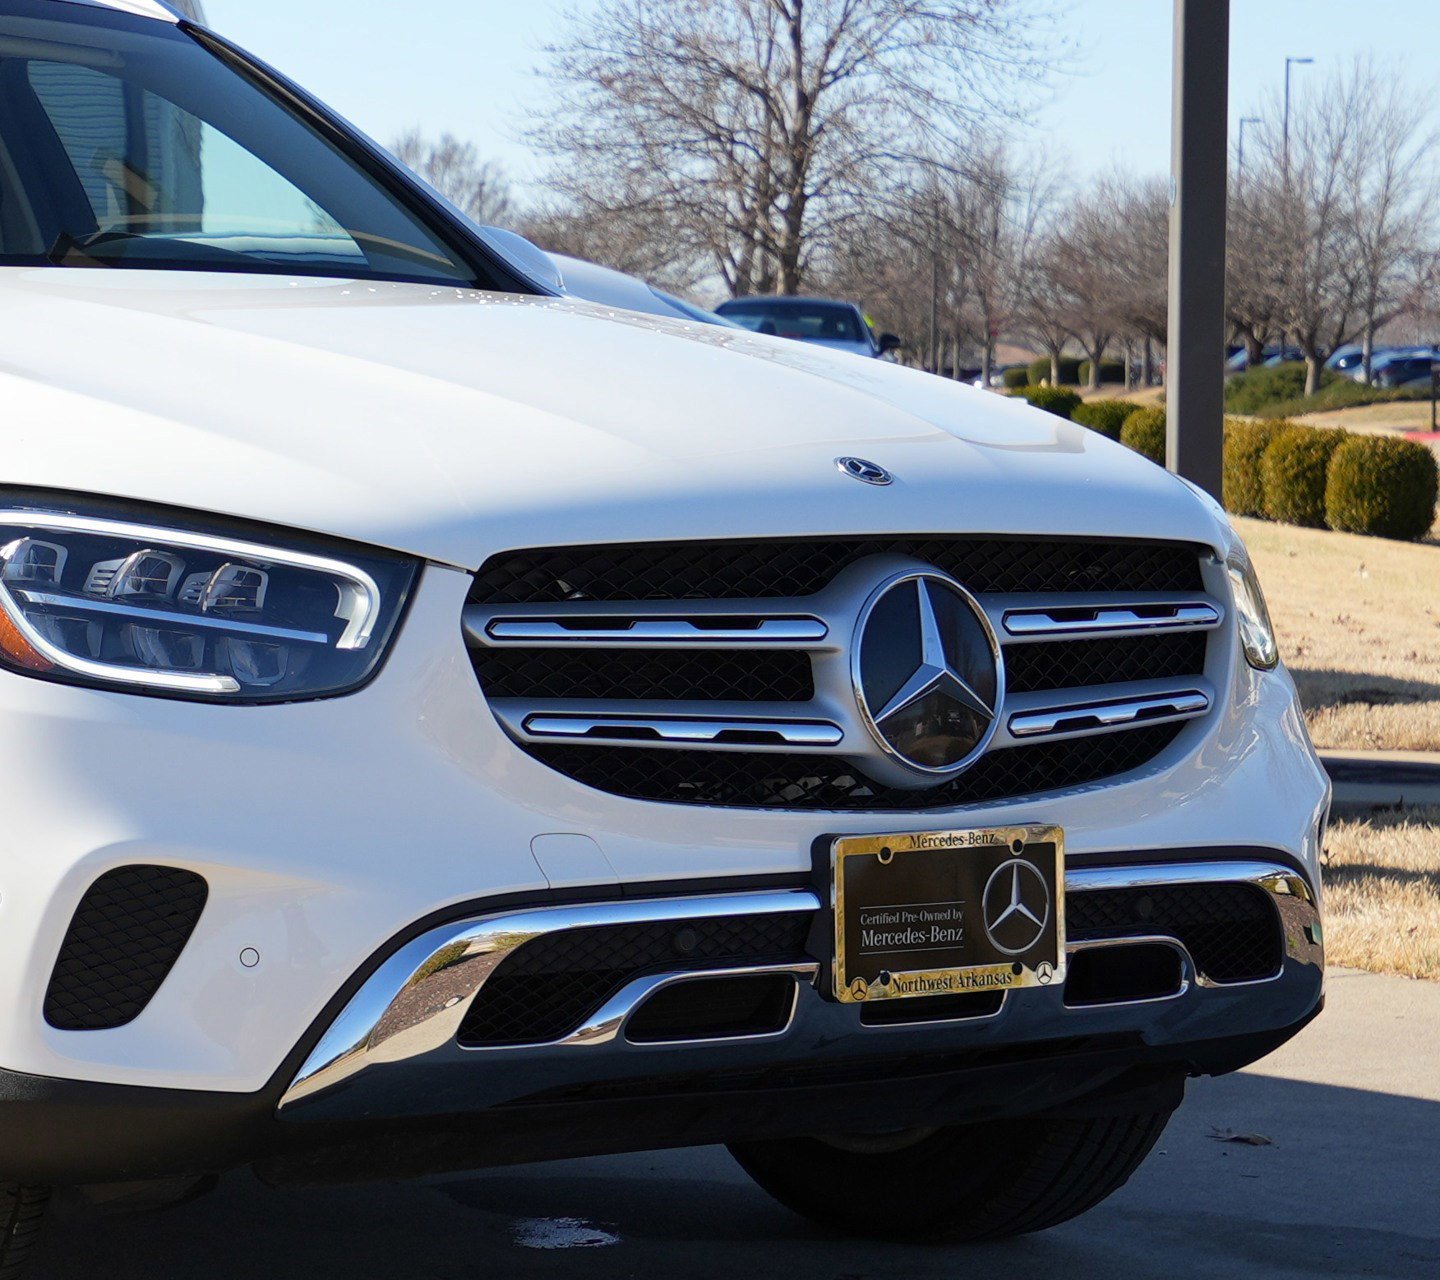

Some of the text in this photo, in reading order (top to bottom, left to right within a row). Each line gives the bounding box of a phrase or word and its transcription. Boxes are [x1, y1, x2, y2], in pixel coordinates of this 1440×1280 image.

[909, 830, 997, 849] Mercedes-Benz
[860, 909, 964, 926] Certified Pre-Owned by
[861, 926, 964, 947] Mercedes-Benz
[893, 971, 1013, 994] Northwest Arkansas
